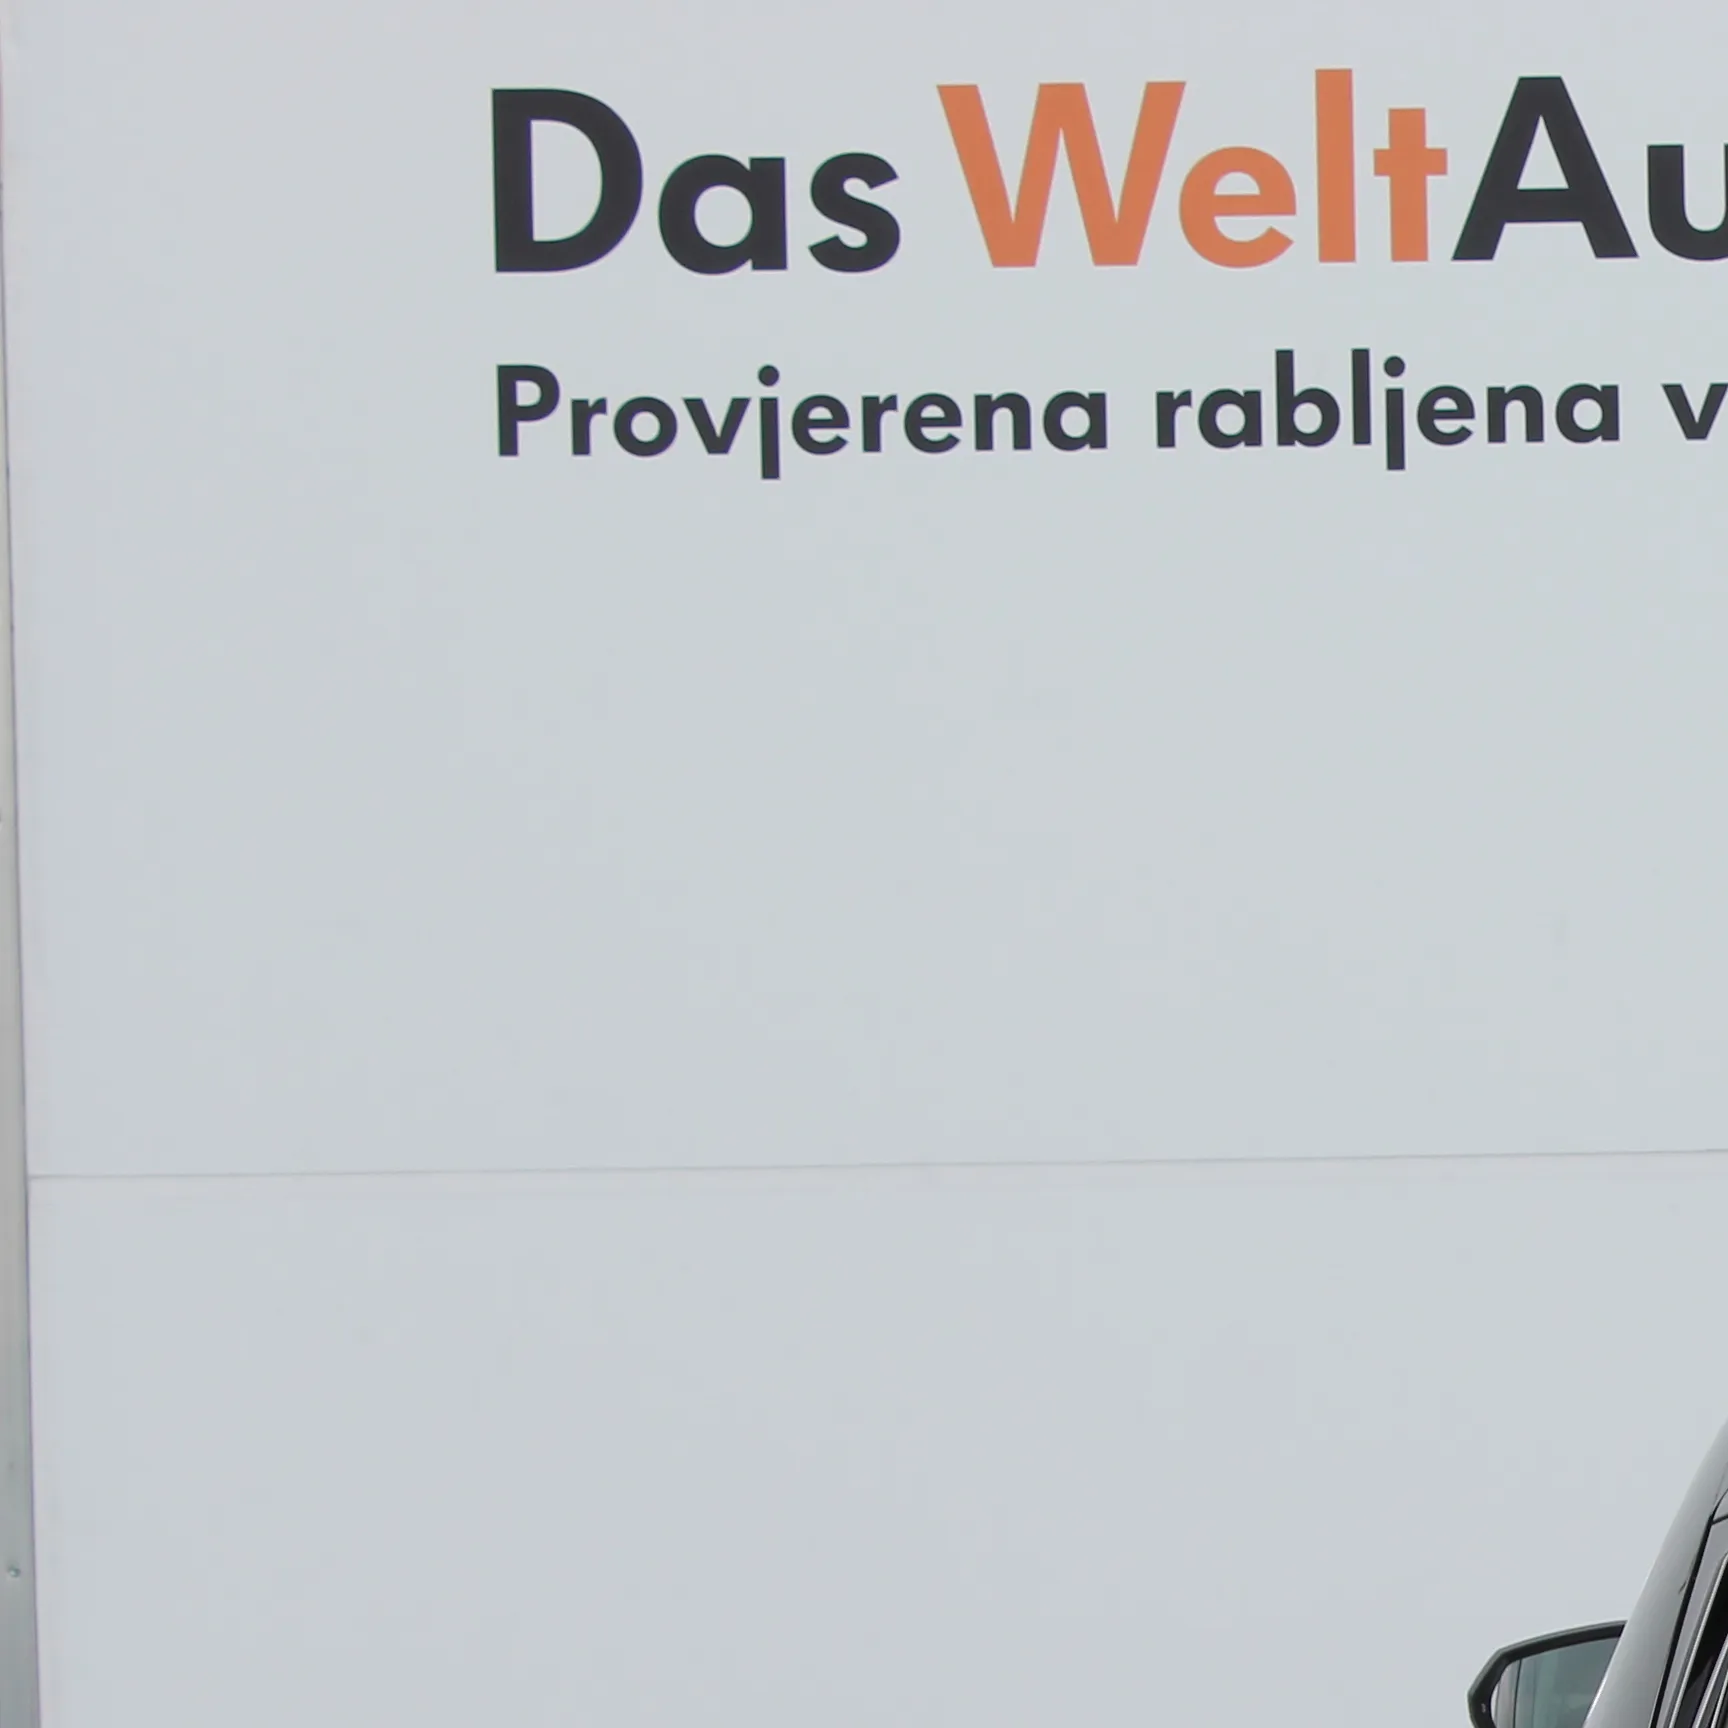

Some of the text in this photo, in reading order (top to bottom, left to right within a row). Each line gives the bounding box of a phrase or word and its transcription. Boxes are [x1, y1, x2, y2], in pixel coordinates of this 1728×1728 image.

[491, 86, 902, 276] Das
[496, 363, 1108, 481] Provjerena
[1155, 348, 1620, 471] rabljena
